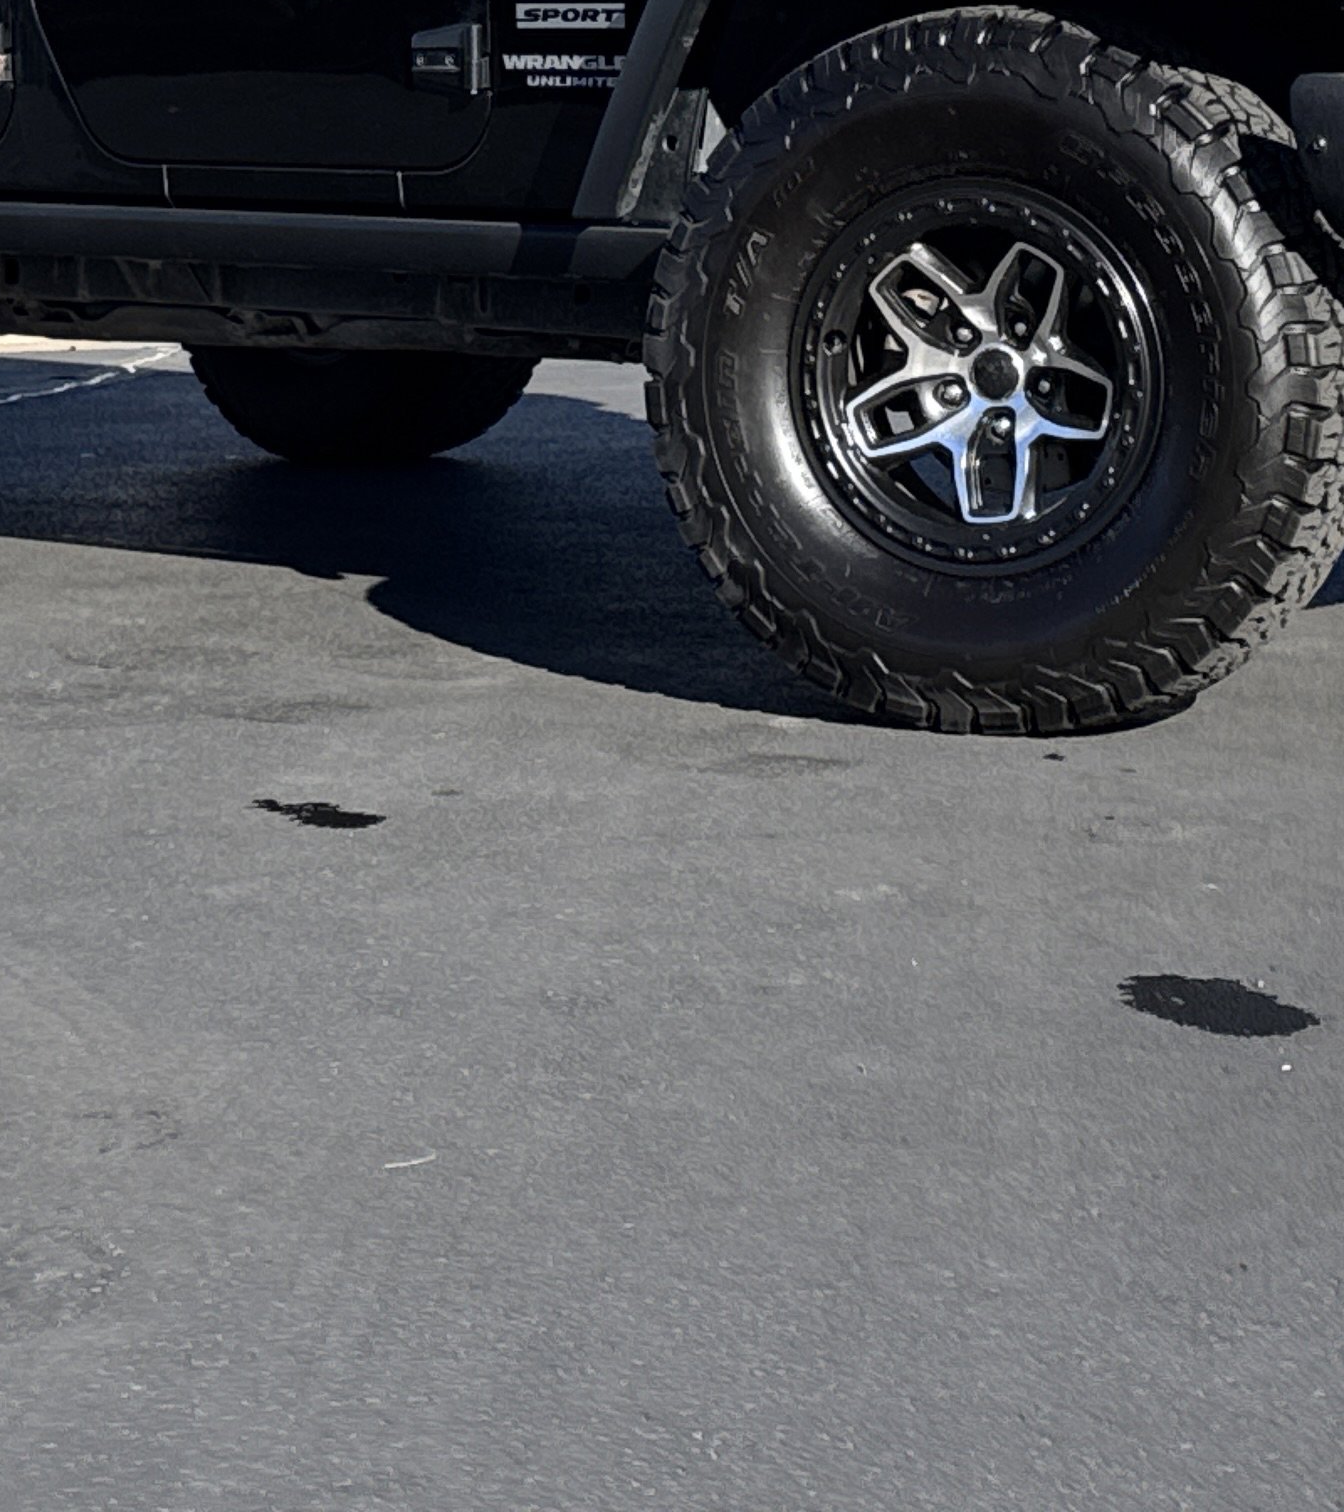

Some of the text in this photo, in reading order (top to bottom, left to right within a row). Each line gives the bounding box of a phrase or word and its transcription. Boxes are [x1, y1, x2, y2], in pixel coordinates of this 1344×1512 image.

[518, 7, 625, 22] SPORT
[502, 53, 627, 70] WRANGLE
[526, 75, 619, 87] UNLIMITE
